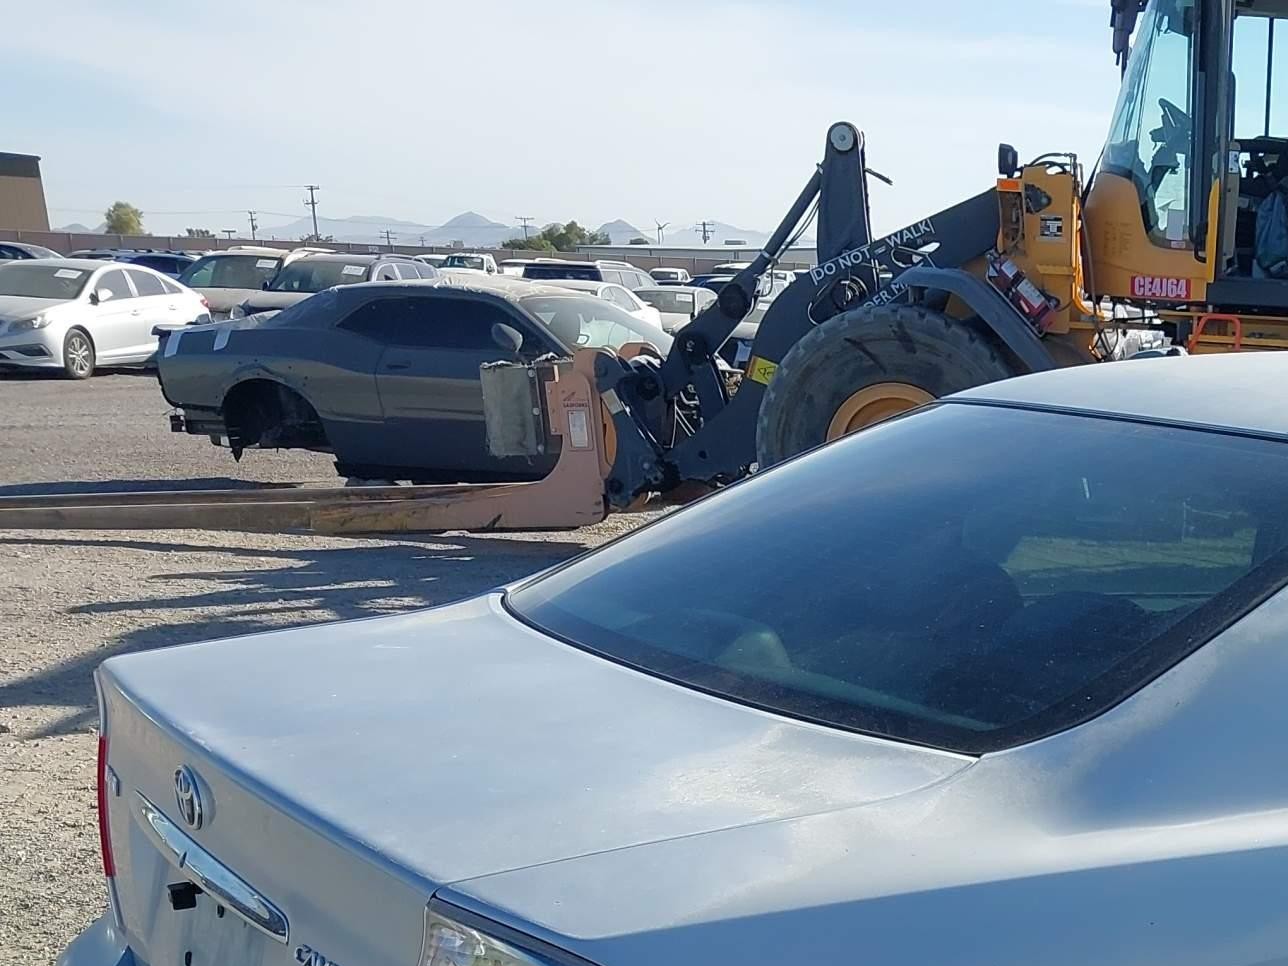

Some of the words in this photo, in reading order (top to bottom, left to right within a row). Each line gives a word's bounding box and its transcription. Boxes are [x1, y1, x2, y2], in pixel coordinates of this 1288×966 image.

[813, 263, 836, 281] DO
[839, 246, 870, 269] NOT
[885, 220, 932, 247] WALK
[1135, 277, 1187, 298] CE4J64
